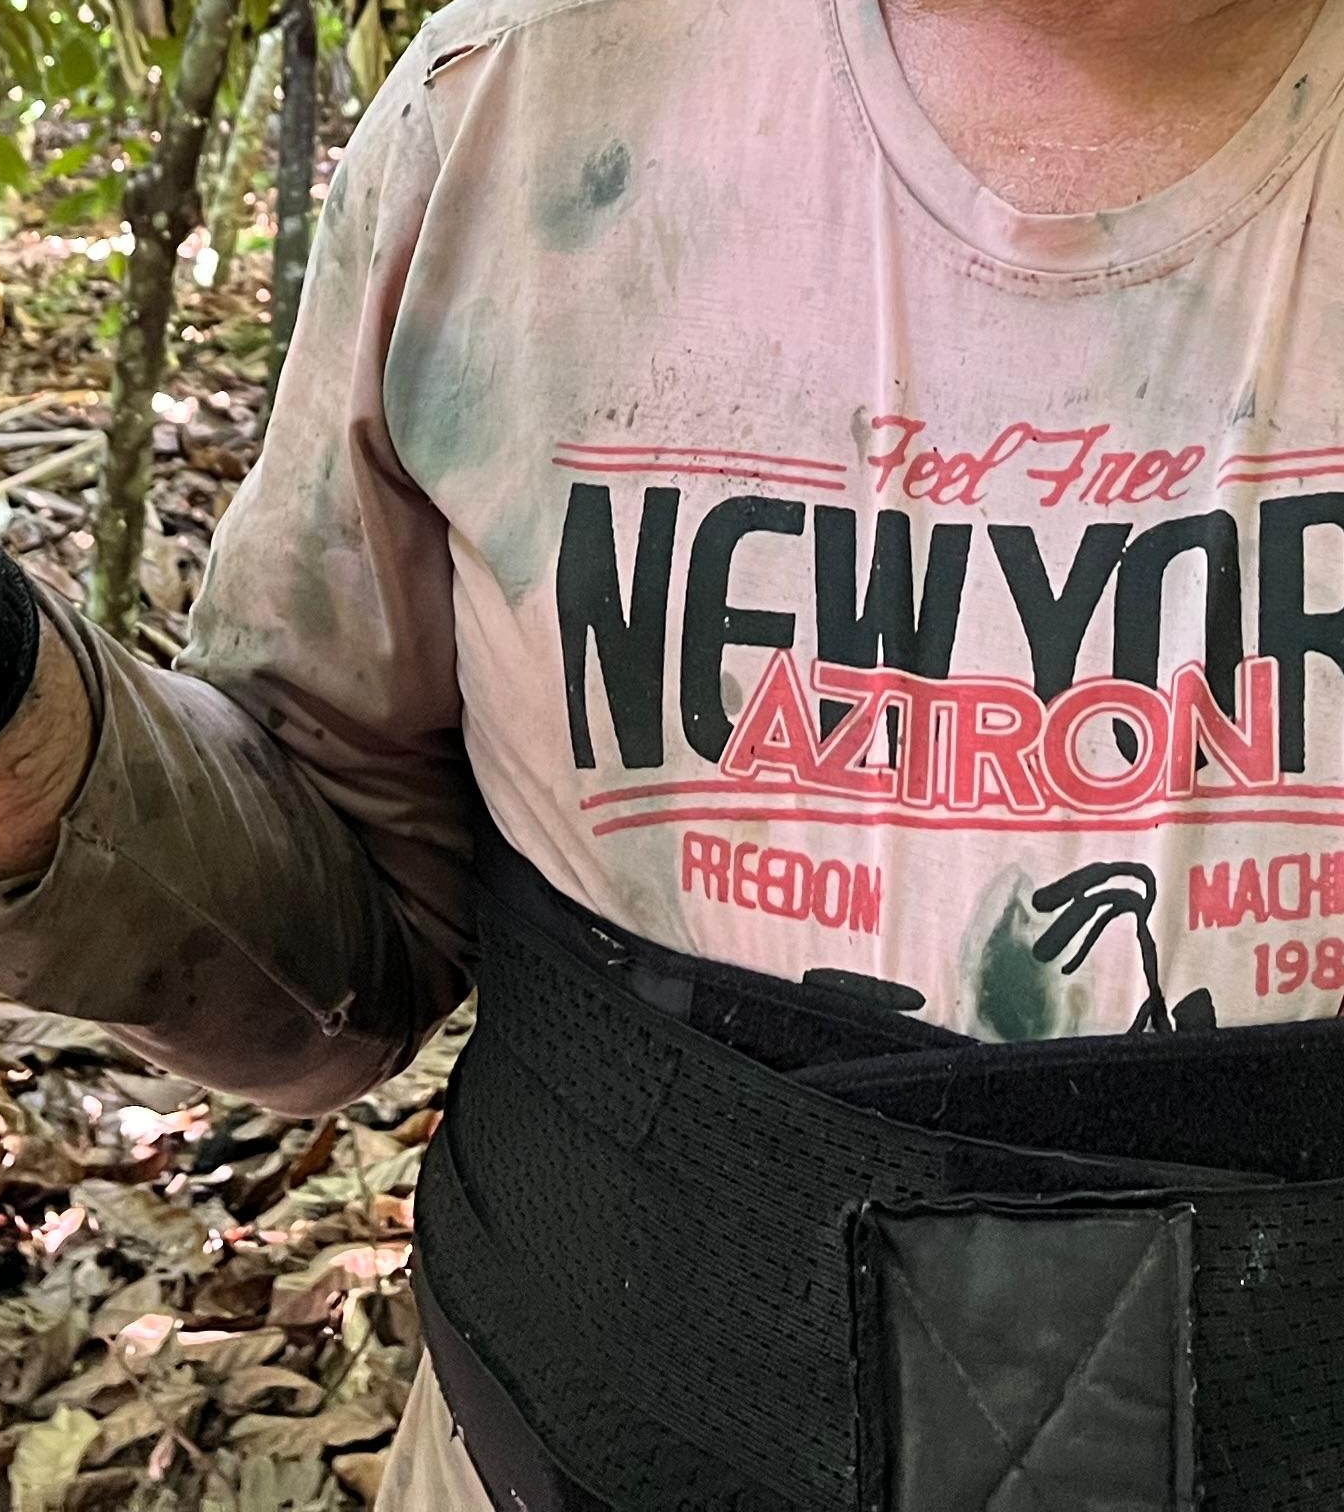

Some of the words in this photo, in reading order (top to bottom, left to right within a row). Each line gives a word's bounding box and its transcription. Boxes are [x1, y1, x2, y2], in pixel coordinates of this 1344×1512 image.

[867, 415, 1035, 506] Feel
[1026, 422, 1206, 507] Free
[720, 646, 1282, 814] AZTRON
